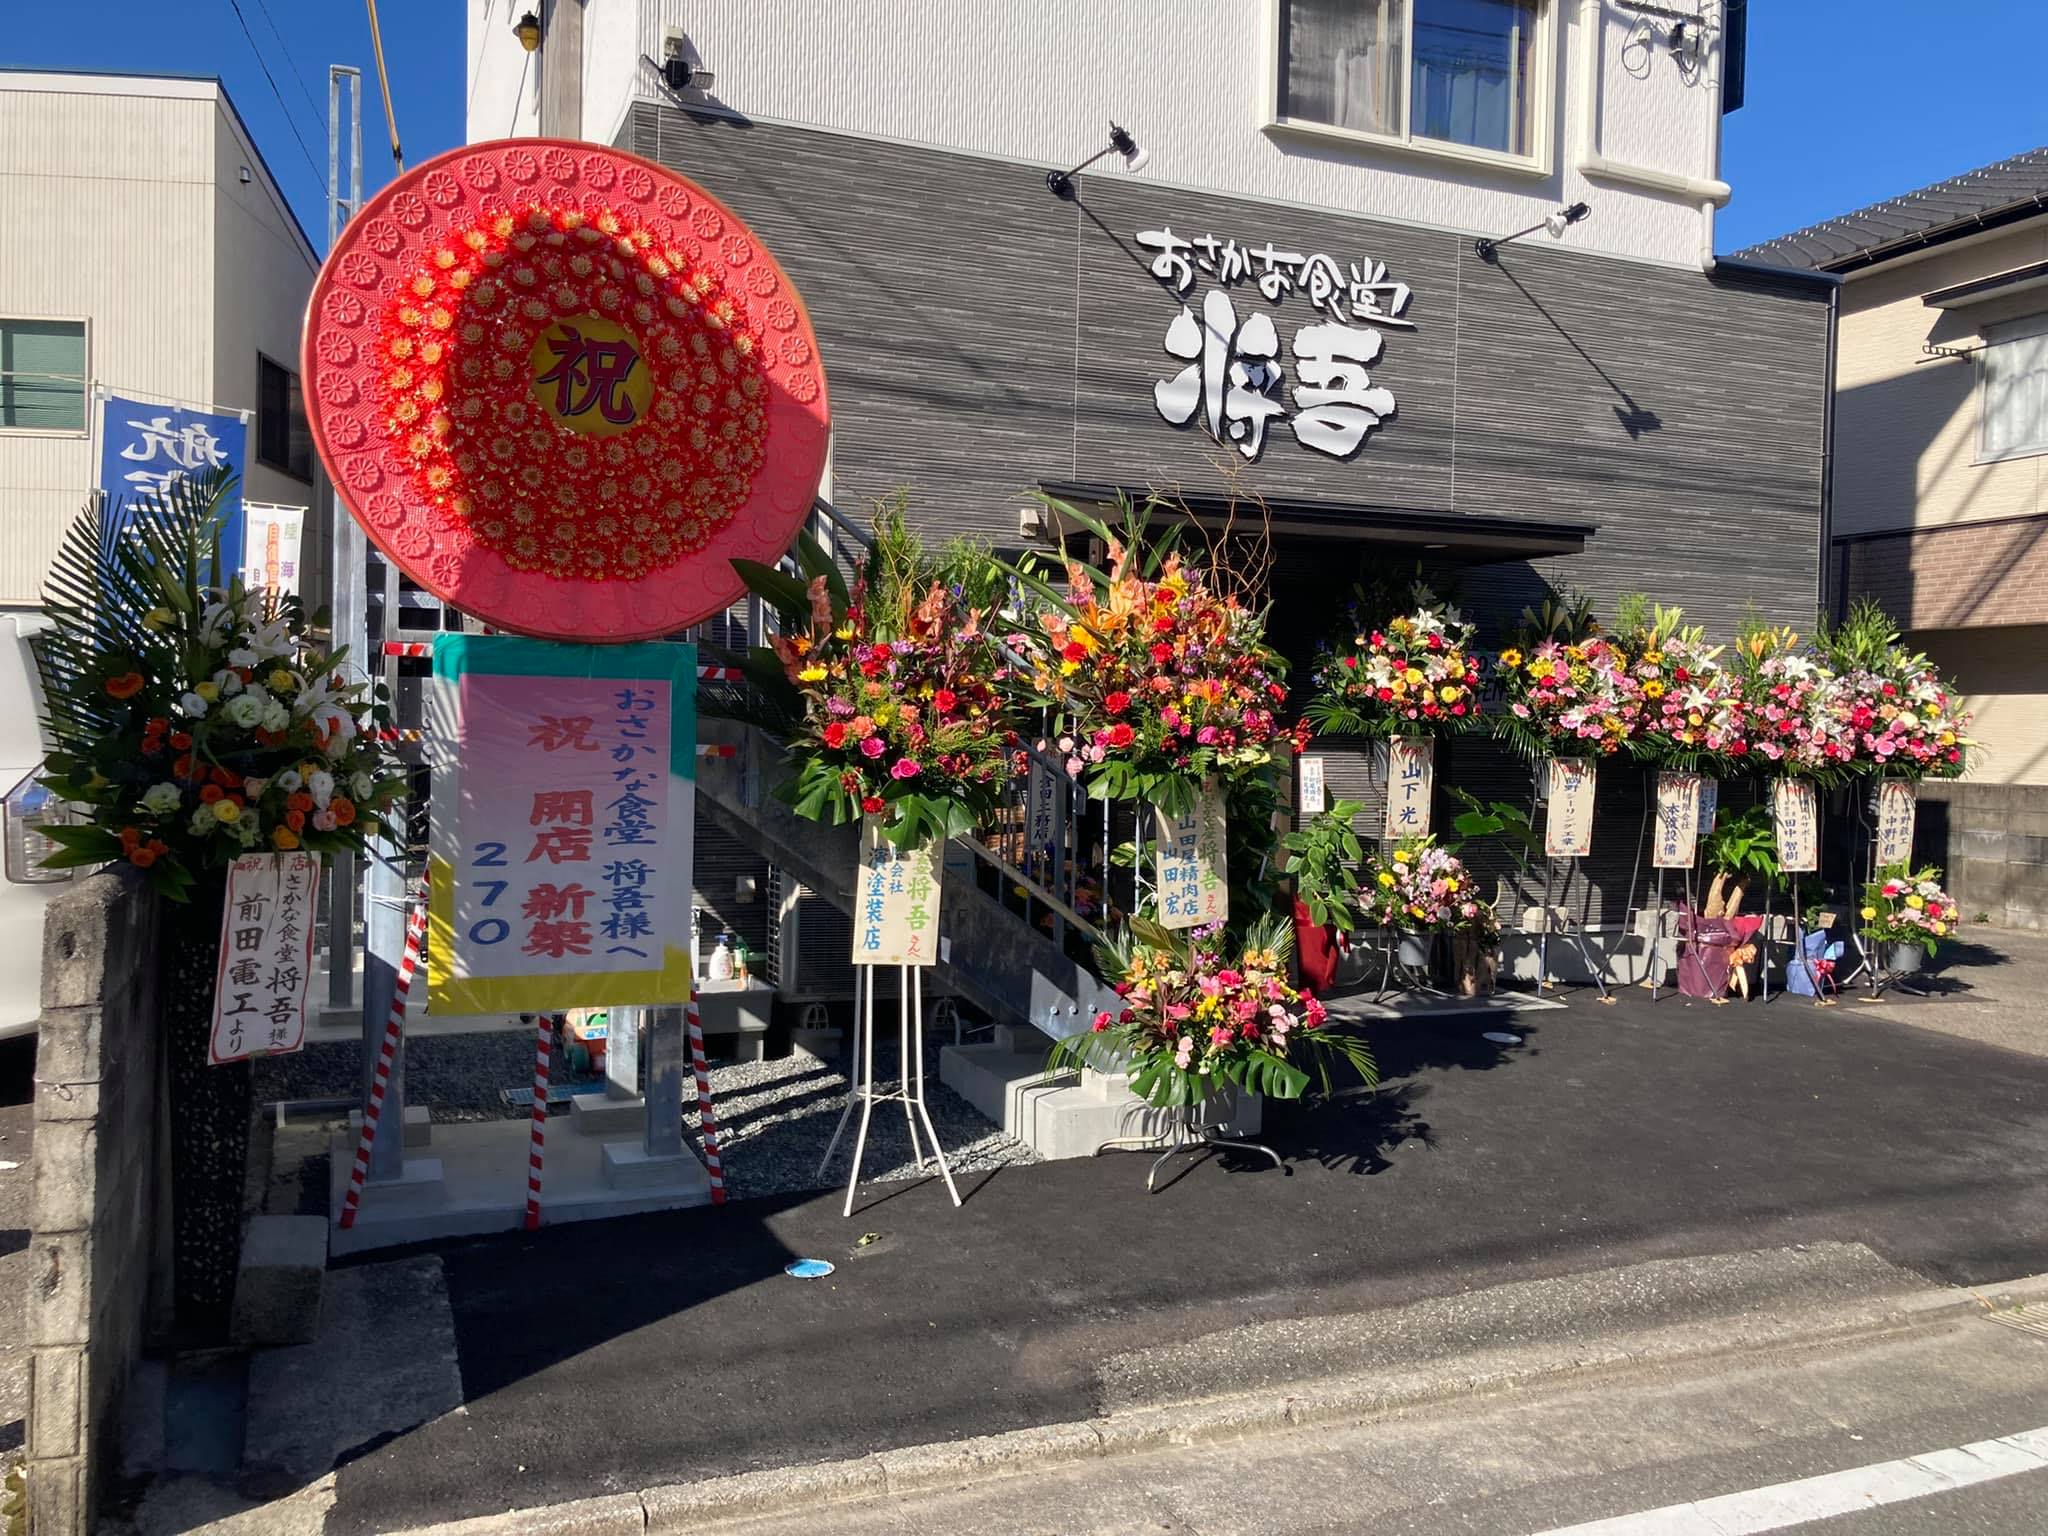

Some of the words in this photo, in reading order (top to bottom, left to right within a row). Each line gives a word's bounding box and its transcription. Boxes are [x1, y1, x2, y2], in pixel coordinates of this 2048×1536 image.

[1136, 227, 1415, 326] おさかな食堂
[536, 324, 639, 424] 祝
[526, 715, 600, 752] 祝
[603, 688, 658, 846] おさかな食堂
[525, 790, 595, 864] 開店
[520, 883, 597, 959] 新築
[599, 858, 656, 958] 将吾様へ
